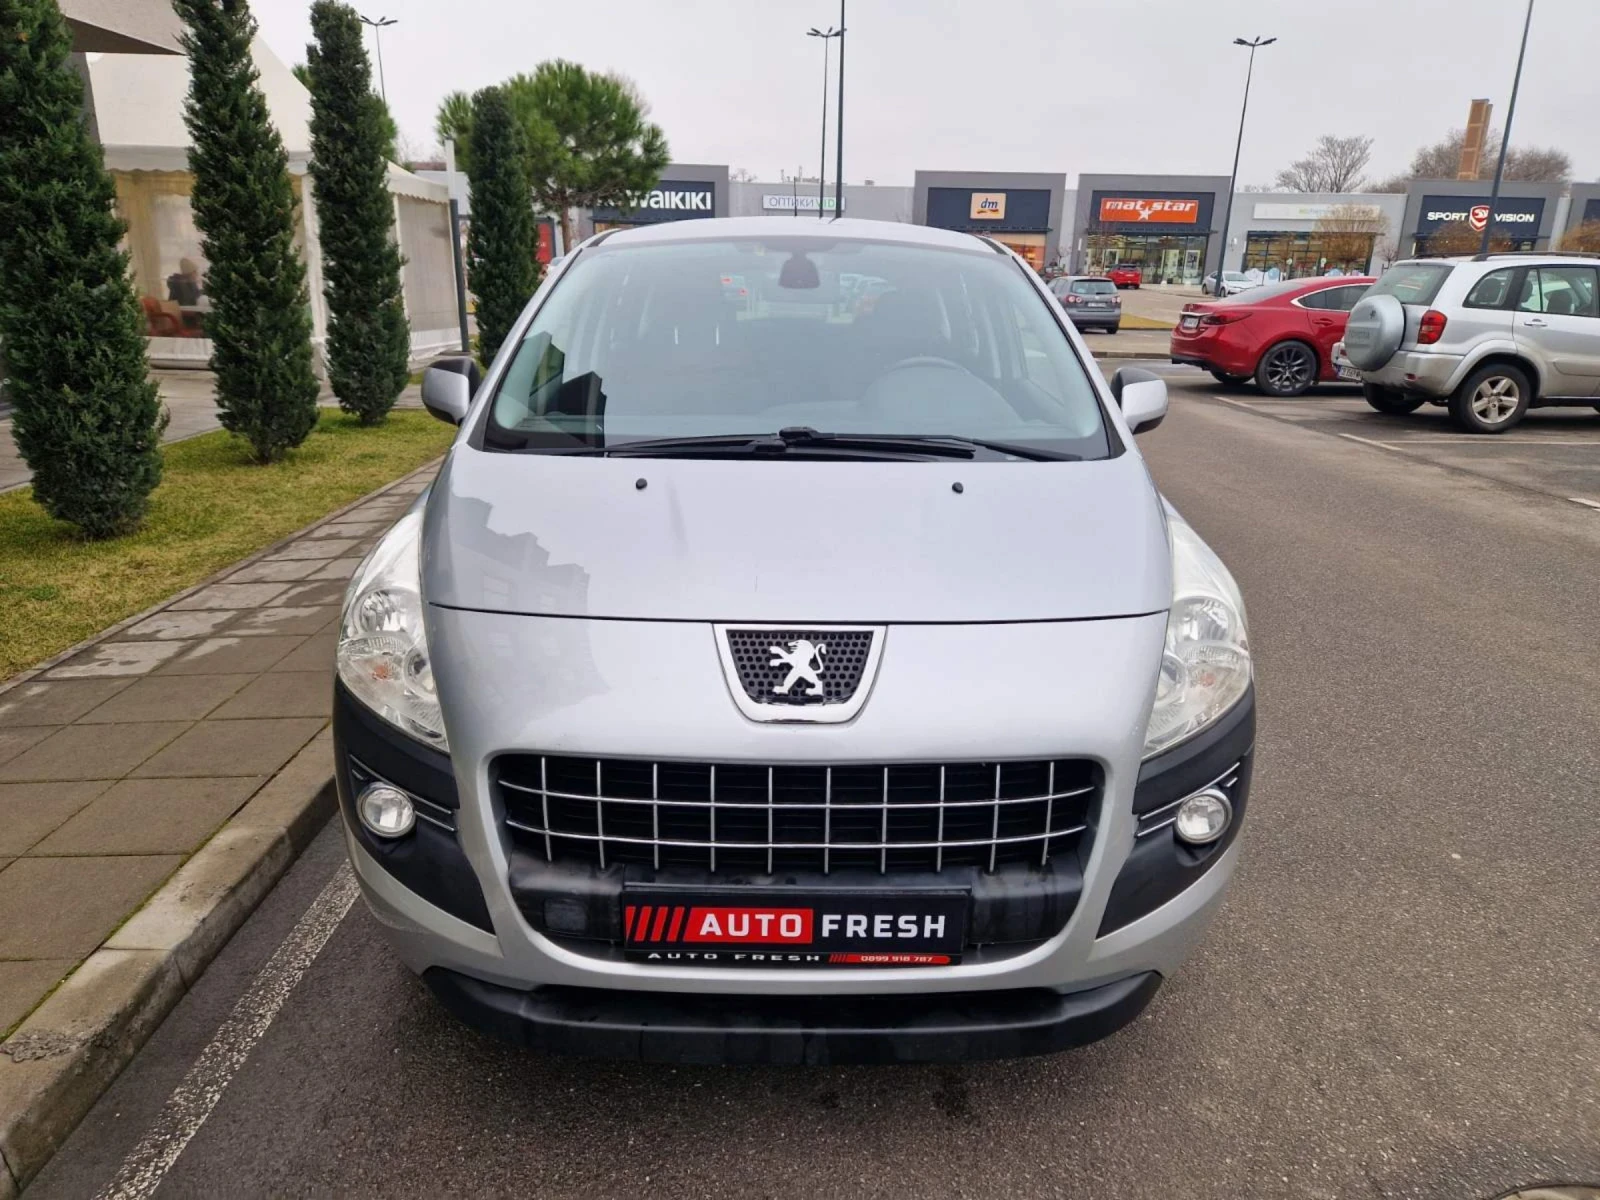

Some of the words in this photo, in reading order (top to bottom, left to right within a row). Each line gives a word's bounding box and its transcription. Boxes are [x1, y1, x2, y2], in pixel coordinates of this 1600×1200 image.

[980, 197, 998, 208] dm
[1151, 200, 1195, 211] star
[1427, 212, 1468, 221] SPORT
[1494, 213, 1535, 222] VISION
[700, 913, 802, 937] AUTO
[822, 914, 945, 938] FRESH
[734, 954, 819, 962] FRESH
